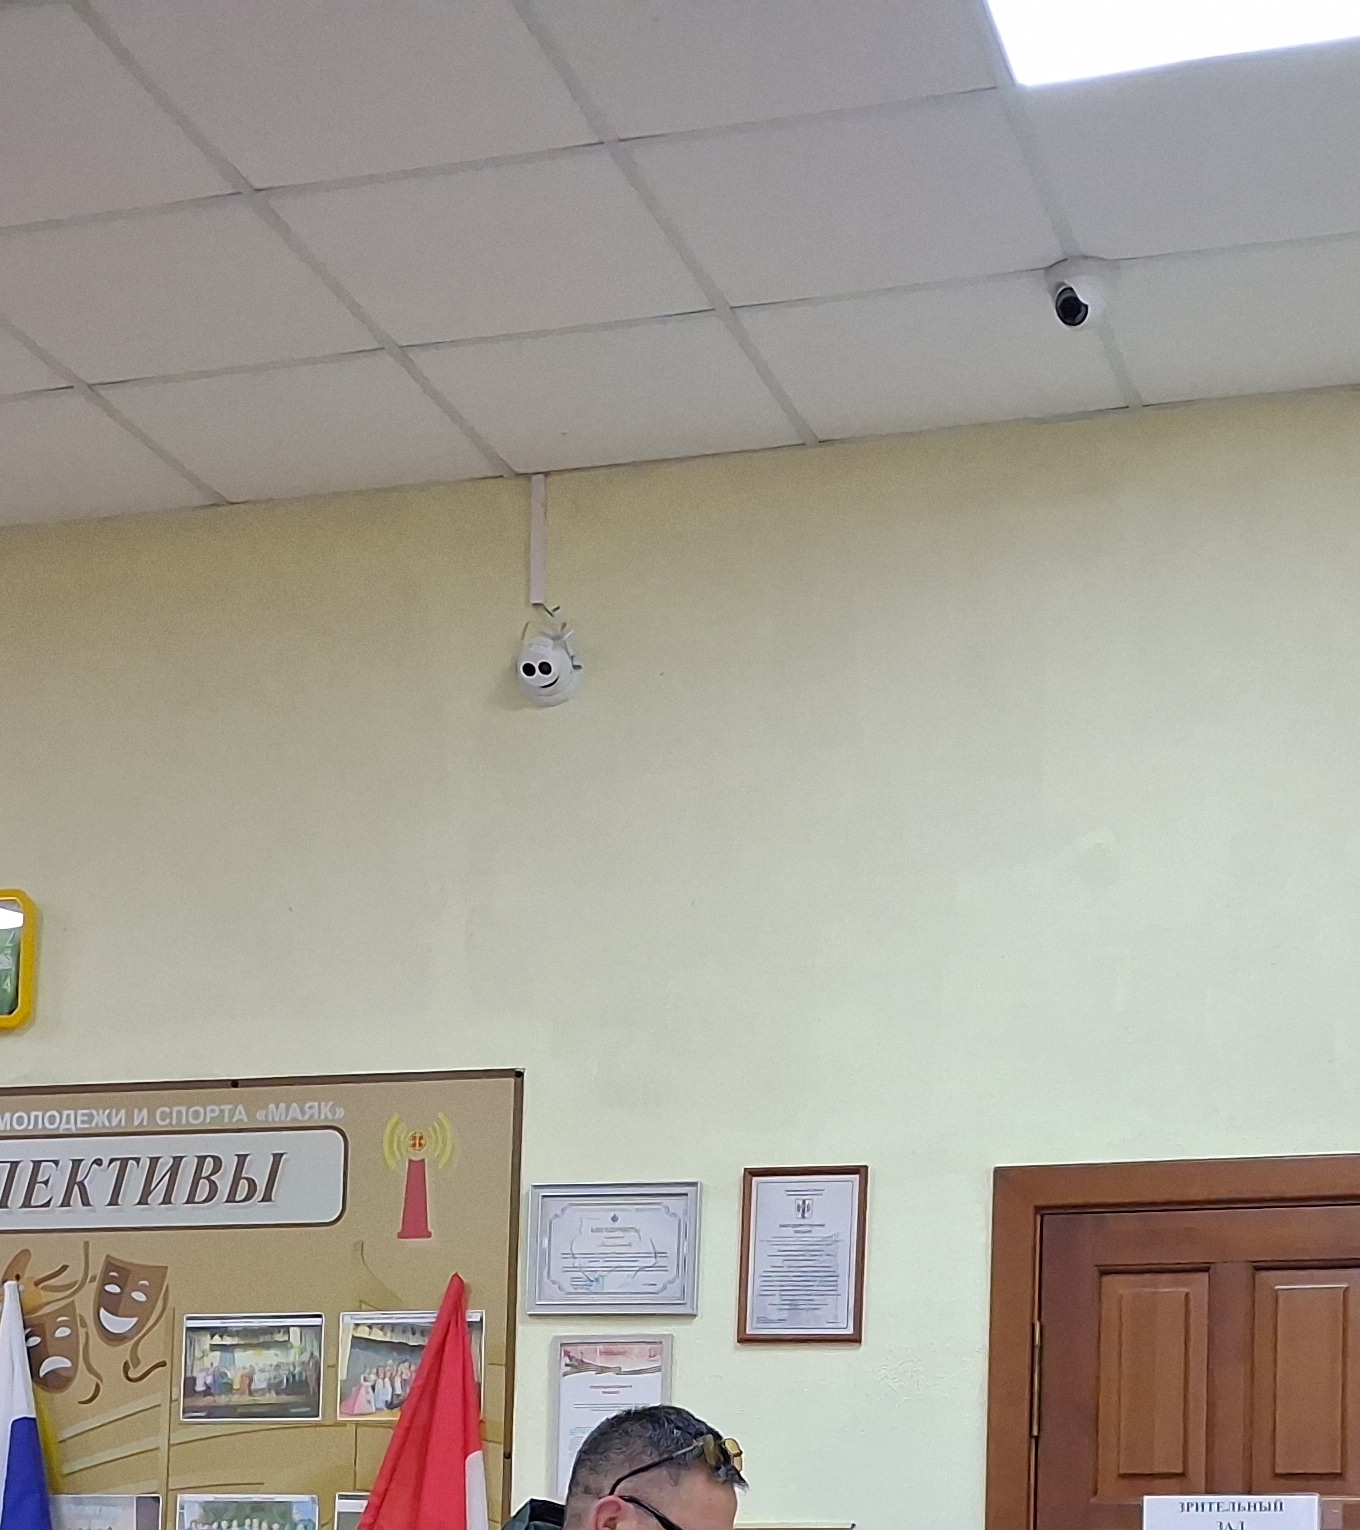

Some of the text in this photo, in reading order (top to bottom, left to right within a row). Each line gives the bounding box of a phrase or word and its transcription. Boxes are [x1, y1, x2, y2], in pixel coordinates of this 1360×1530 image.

[133, 1108, 149, 1126] И
[155, 1104, 248, 1126] СПОРТА
[256, 1101, 346, 1122] «МАЯК»
[1179, 1499, 1284, 1513] ЗРИТЕЛЬНЫЙ
